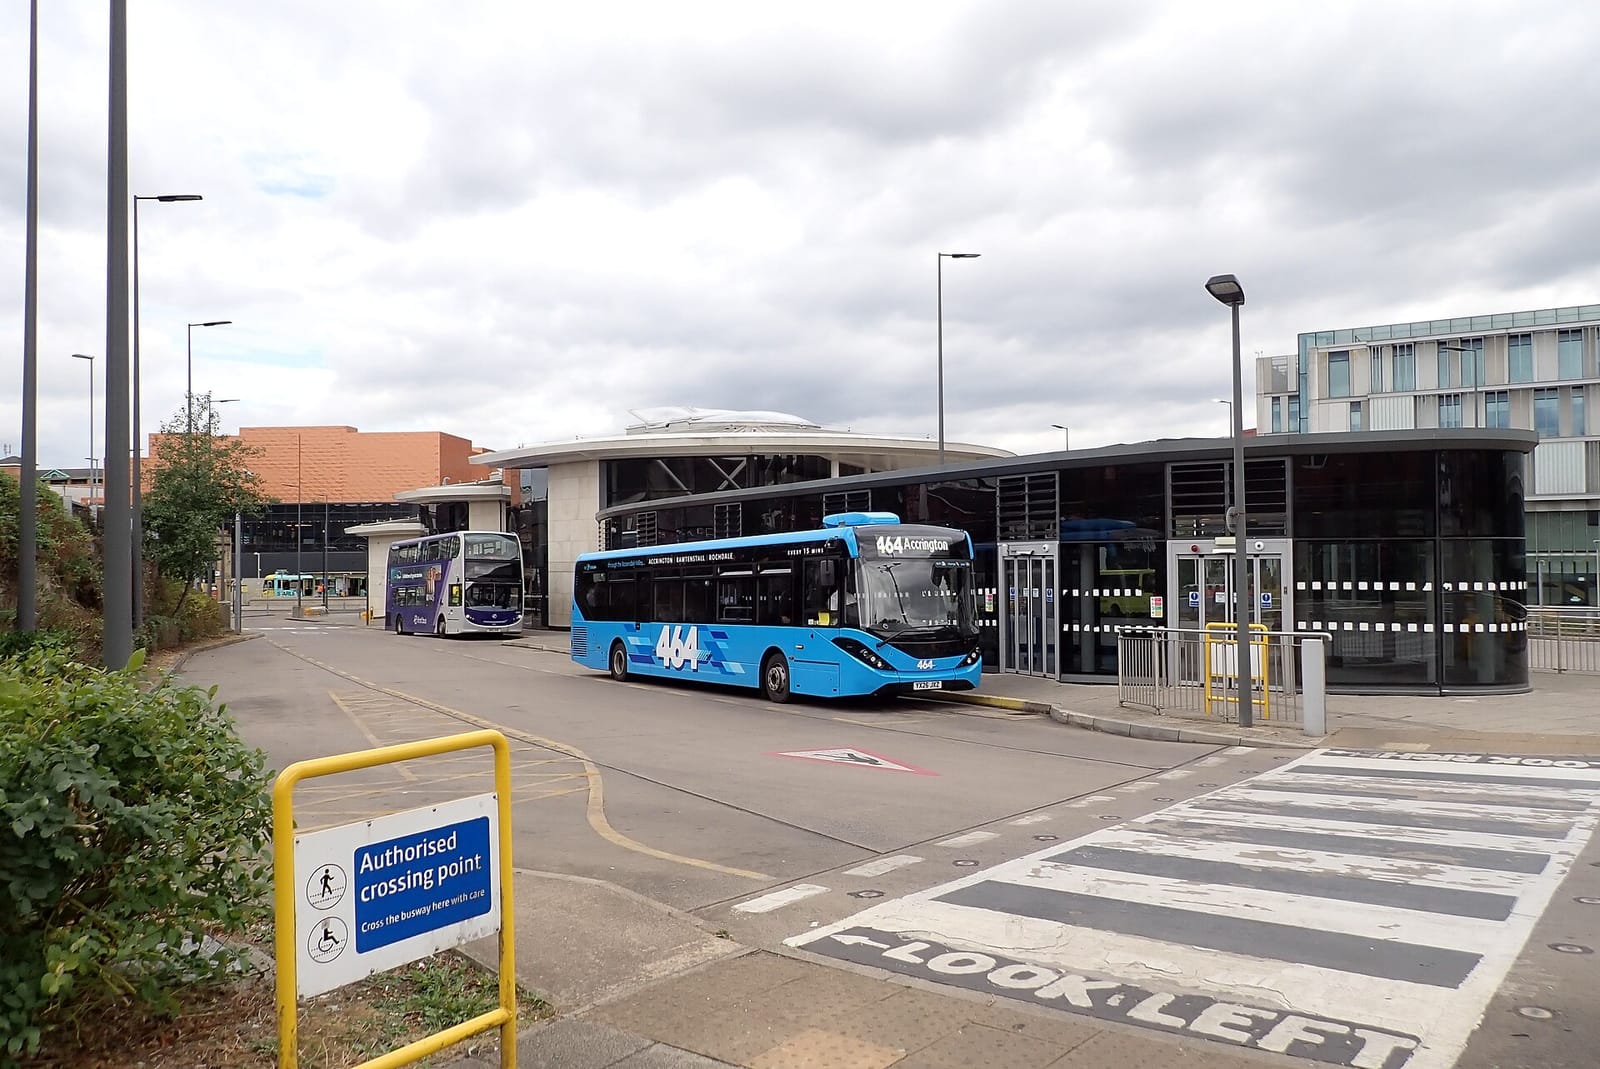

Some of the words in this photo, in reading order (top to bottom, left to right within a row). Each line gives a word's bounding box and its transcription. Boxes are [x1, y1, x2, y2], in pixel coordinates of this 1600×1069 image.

[648, 557, 673, 565] ACCRINGTON
[676, 554, 706, 563] RAWTENSTALL
[708, 552, 734, 561] ROCHDALE
[803, 547, 810, 555] 15
[876, 536, 903, 554] 464
[903, 537, 949, 553] Accrington
[656, 625, 699, 671] 464
[917, 659, 934, 670] 464
[359, 831, 457, 875] Authorised
[360, 868, 434, 903] crossing
[437, 853, 482, 886] point
[361, 918, 384, 934] Cross
[385, 912, 400, 926] the
[401, 905, 431, 922] busway
[432, 898, 450, 912] here
[450, 893, 468, 907] with
[469, 888, 485, 901] care
[881, 941, 1123, 1008] LOOK
[1126, 992, 1424, 1069] LEFT
